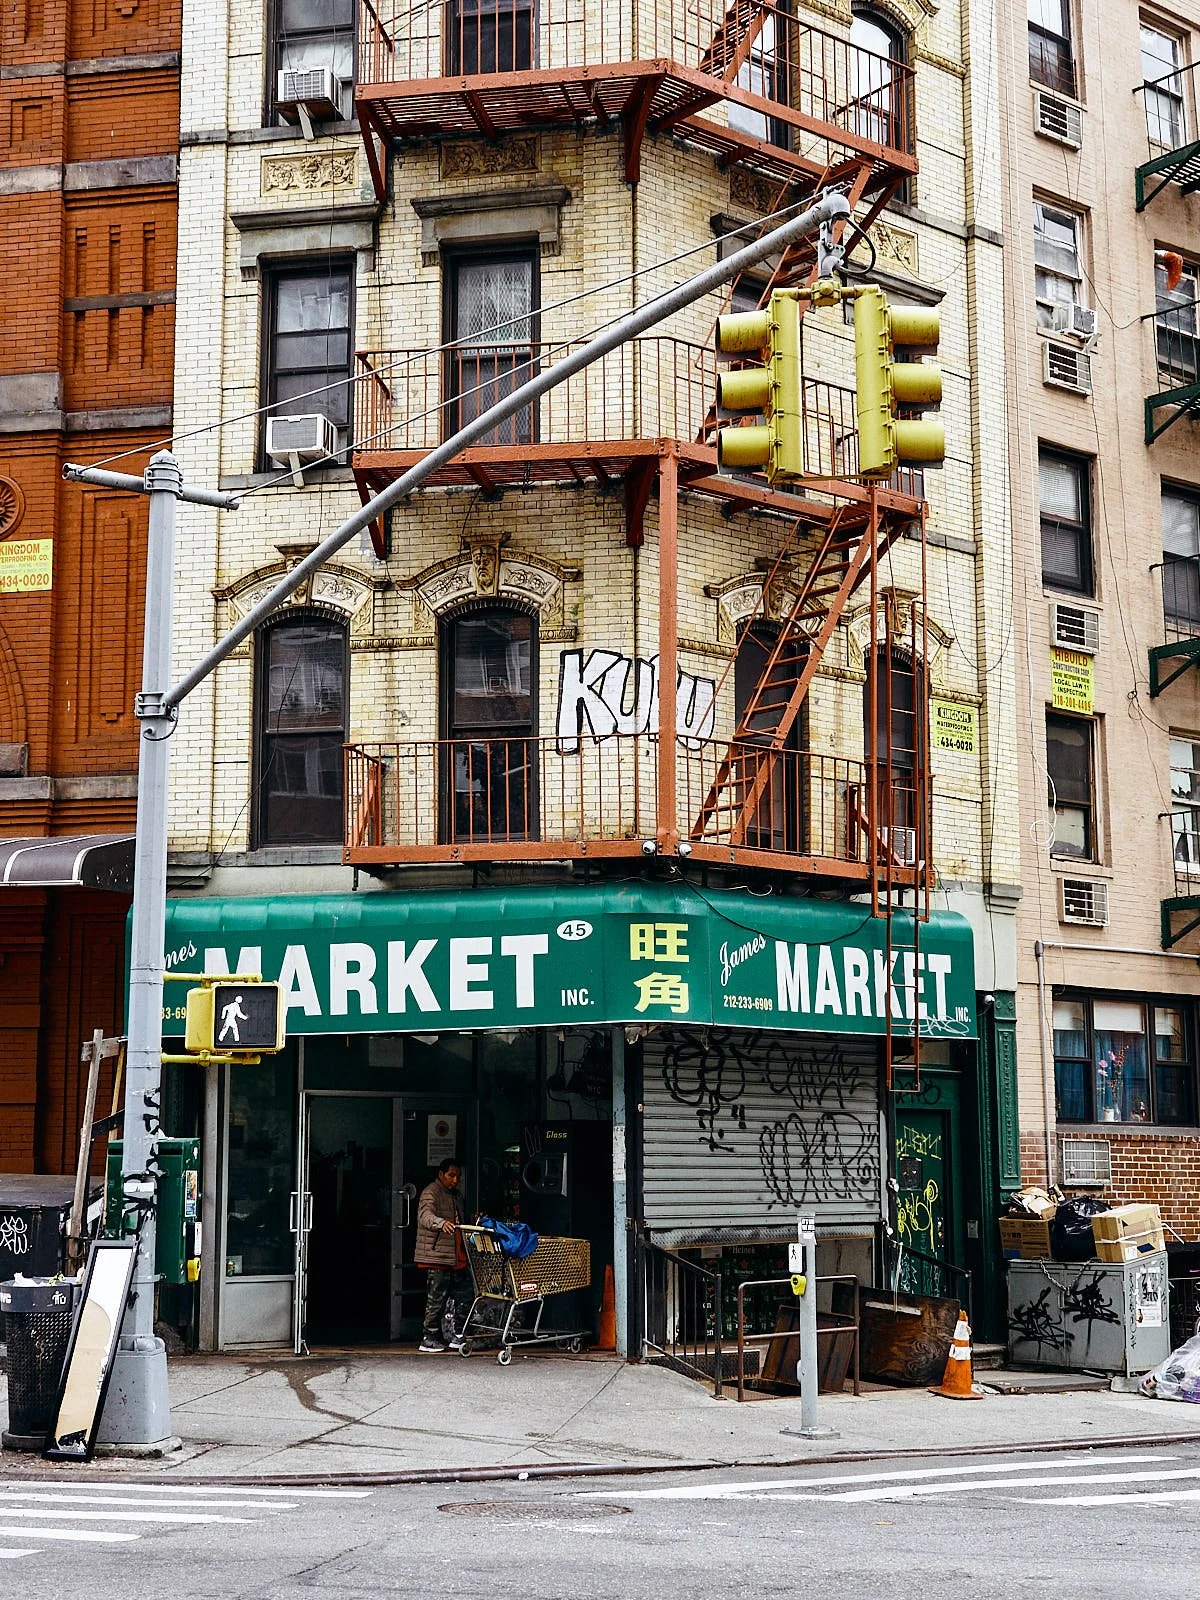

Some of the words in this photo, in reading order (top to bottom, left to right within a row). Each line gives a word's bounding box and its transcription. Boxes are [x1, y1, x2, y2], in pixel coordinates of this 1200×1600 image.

[1055, 650, 1087, 666] HIBUILD
[1055, 678, 1071, 687] LOCAL
[1057, 686, 1087, 698] INSPECTION
[941, 736, 973, 751] 434-0020
[562, 924, 587, 937] 45
[630, 923, 690, 1014] 旺角
[719, 934, 766, 987] James
[775, 940, 951, 1021] MARKET
[955, 1006, 971, 1022] INC.
[561, 988, 595, 1006] INC.
[723, 995, 773, 1011] 212-233-6909
[546, 1130, 567, 1139] Glass
